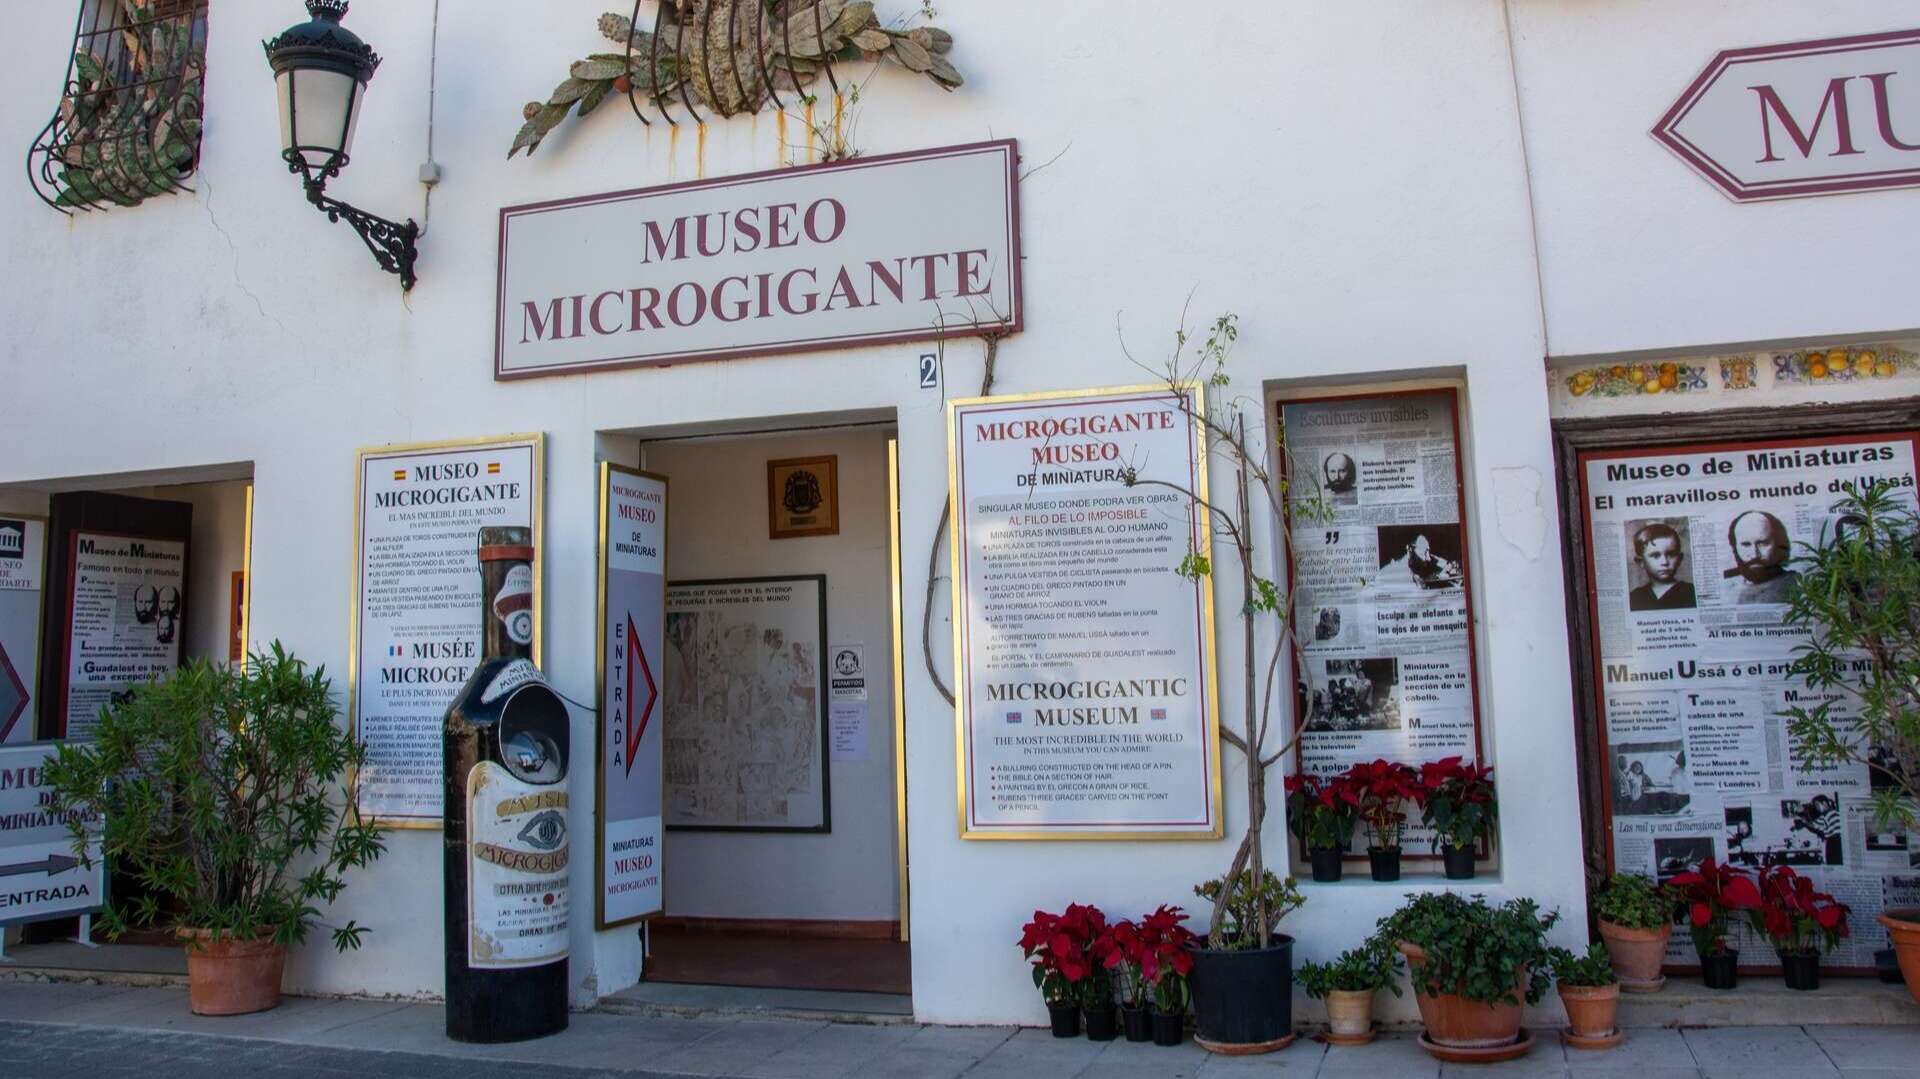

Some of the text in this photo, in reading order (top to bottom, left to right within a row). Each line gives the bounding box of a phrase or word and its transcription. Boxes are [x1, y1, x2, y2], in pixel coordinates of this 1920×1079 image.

[1746, 72, 1920, 164] MU
[641, 198, 847, 264] MUSEO
[519, 249, 992, 344] MICROGIGANTE
[921, 356, 936, 387] 2
[976, 410, 1175, 442] MICROGIGANTE
[1301, 408, 1367, 428] Esculturas
[1032, 442, 1120, 465] MUSEO
[1606, 444, 1895, 482] Museo de Miniaturas
[414, 462, 479, 482] MUSEO
[1017, 474, 1036, 487] DE
[374, 482, 520, 508] MICROGIGANTE
[612, 484, 662, 504] MICROGIGANTE
[978, 494, 1178, 513] SINGULAR MUSEO DONDE PODRA VER OBRAS
[1595, 495, 1614, 510] El
[1626, 487, 1740, 507] maravilloso
[1750, 481, 1817, 500] mundo
[618, 504, 656, 524] MUSEO
[1008, 509, 1148, 526] AL FILO DE LO IMPOSIBLE
[632, 532, 641, 542] DE
[990, 522, 1168, 540] MINIATURAS INVISIBLES AL OJO HUMANO
[80, 540, 116, 556] Museo
[130, 543, 180, 560] Miniaturas
[616, 542, 656, 558] MINIATURAS
[78, 562, 111, 573] Famoso
[113, 566, 124, 574] en
[124, 566, 142, 575] todo
[1422, 609, 1453, 618] elefante
[1378, 626, 1389, 634] los
[1392, 625, 1407, 635] ojos
[1410, 624, 1419, 633] de
[1708, 630, 1719, 638] Al
[1721, 629, 1737, 638] filo
[1754, 629, 1763, 637] lo
[1766, 627, 1813, 638] imposible
[412, 636, 476, 660] MUSÉE
[1404, 662, 1450, 670] Miniaturas
[1607, 664, 1673, 683] Manuel
[1677, 660, 1725, 680] Ussá
[1732, 664, 1741, 677] ó
[1747, 663, 1762, 675] el
[614, 623, 623, 766] ENTRADA
[986, 678, 1187, 702] MICROGIGANTIC
[1034, 706, 1138, 726] MUSEUM
[994, 733, 1184, 746] THE MOST INCREDIBLE IN THE WORLD
[1322, 763, 1349, 773] golpe
[1619, 820, 1722, 834] Las mil y una dimensiones
[612, 836, 654, 852] MINIATURAS
[614, 855, 652, 876] MUSEO
[608, 876, 658, 896] MICROGIGANTE
